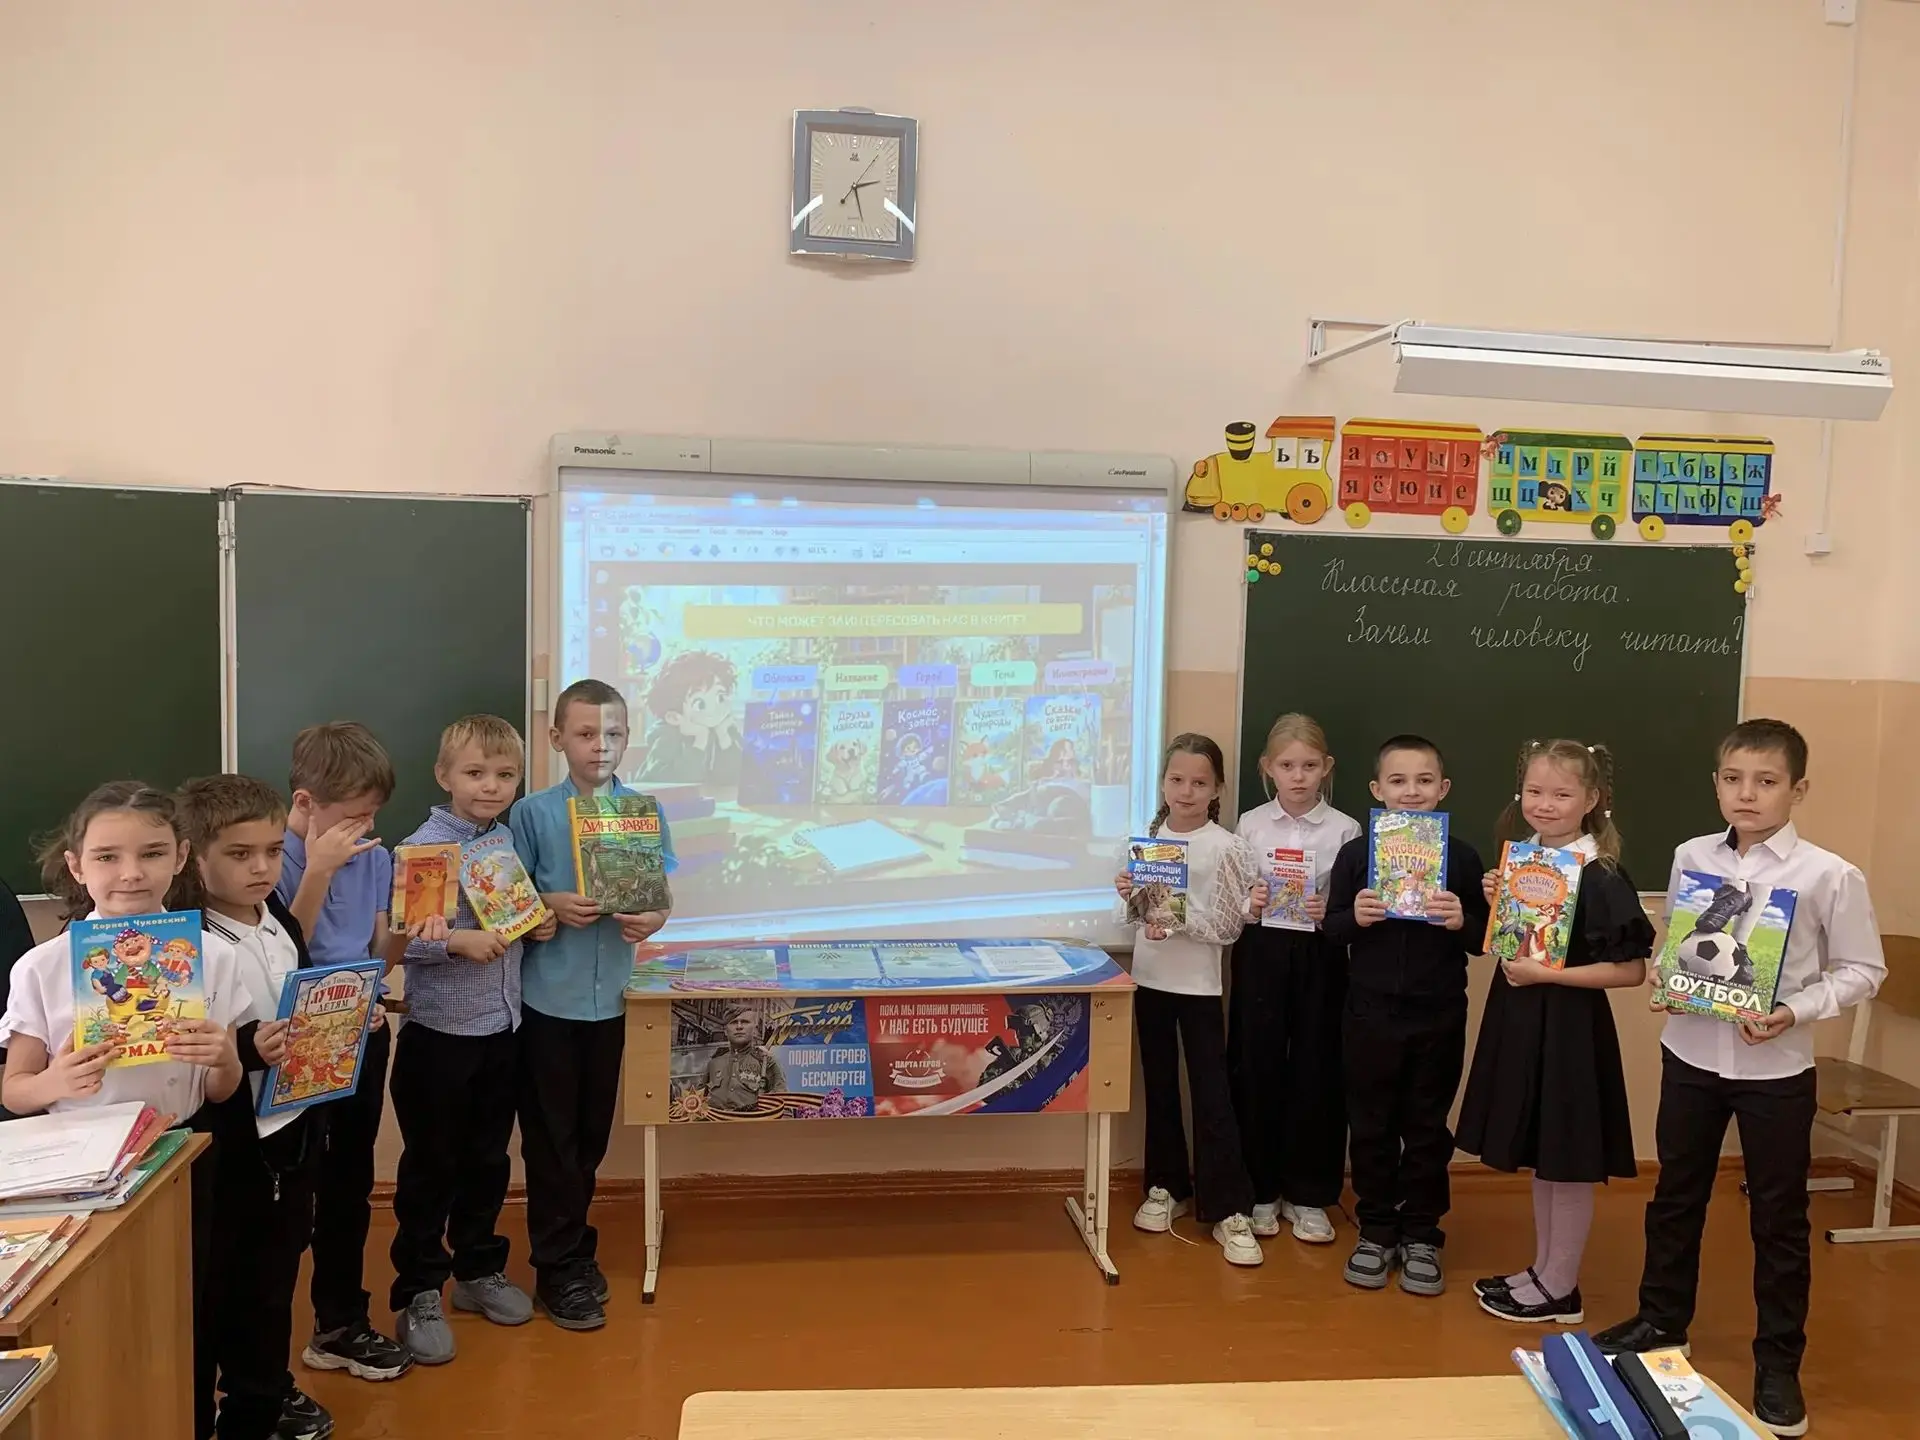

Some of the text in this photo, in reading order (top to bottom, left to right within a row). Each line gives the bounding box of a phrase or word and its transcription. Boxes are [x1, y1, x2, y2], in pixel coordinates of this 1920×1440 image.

[574, 446, 616, 456] Panasonic
[1348, 446, 1470, 468] а о у ы э
[1499, 450, 1616, 476] н м л р й
[1642, 457, 1766, 481] г д б в з ж
[1346, 474, 1467, 499] я ё ю и е
[1492, 486, 1613, 507] щ ц х ч
[1638, 488, 1762, 515] к т п ф с ш
[1426, 541, 1464, 567] 28
[1320, 557, 1631, 617] Классная работа.
[748, 616, 775, 627] ЧТО
[778, 614, 826, 627] МОЖЕТ
[943, 614, 967, 626] НАС
[971, 615, 978, 625] В
[978, 613, 1027, 626] КНИГЕ?
[1347, 604, 1744, 672] Зачем человеку читать?
[835, 672, 878, 683] Название
[581, 818, 658, 833] ДИНОЗАВРЫ
[1391, 855, 1427, 872] ДЕТЯМ
[1519, 875, 1559, 891] СКАЗКИ
[92, 915, 187, 930] Корней Чуковский
[1668, 973, 1763, 1012] ФУТБОЛ
[317, 999, 350, 1013] ДЕТЯМ
[826, 999, 857, 1014] 1945
[879, 1004, 899, 1016] ПОКА
[901, 1004, 915, 1016] МЫ
[916, 1003, 949, 1016] ПОМНИМ
[879, 1017, 989, 1036] У НАС ЕСТЬ БУДУЩЕЕ
[788, 1048, 867, 1067] ПОДВИГ ГЕРОЕВ
[895, 1060, 940, 1069] ПАРТА ГЕРОЯ
[801, 1070, 866, 1088] БЕССМЕРТЕН
